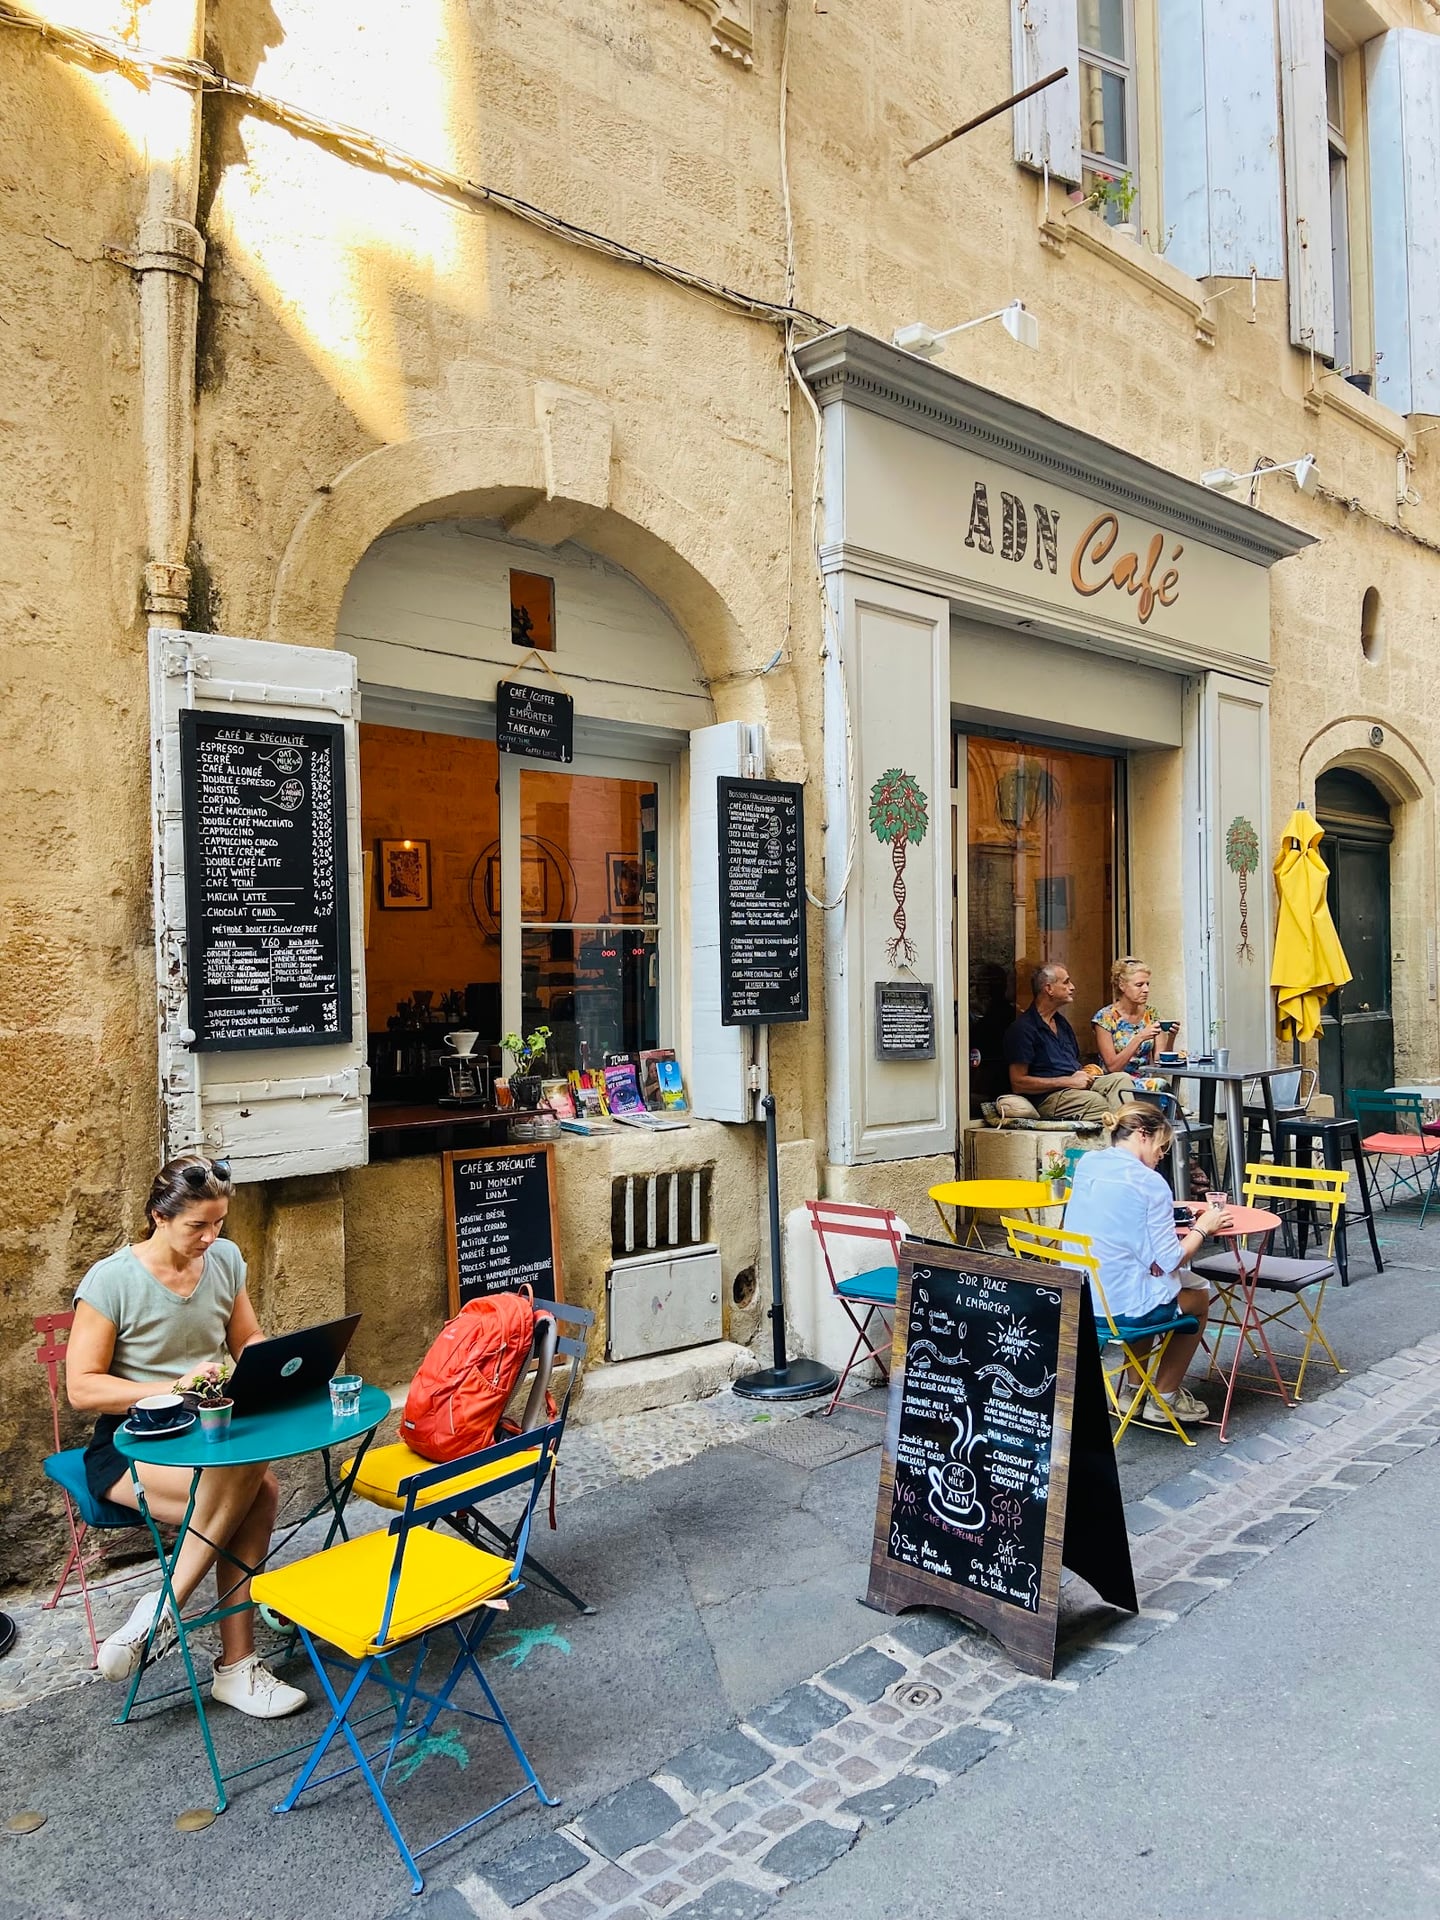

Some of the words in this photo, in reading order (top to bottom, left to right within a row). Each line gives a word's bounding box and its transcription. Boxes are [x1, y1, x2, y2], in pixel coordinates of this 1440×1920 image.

[964, 481, 1061, 575] ADN
[1070, 512, 1184, 624] Café
[510, 687, 527, 698] CAFÉ
[509, 707, 553, 723] EMPORTER
[218, 729, 240, 740] CAFÉ
[245, 731, 254, 740] DE
[507, 722, 550, 737] TAKEAWAY
[200, 742, 245, 755] ESPRESSO
[279, 750, 292, 758] OAT
[201, 753, 231, 764] SERRÉ
[202, 763, 223, 774] CAFÉ
[227, 765, 262, 777] ALLONGÉ
[201, 774, 234, 784] DOUBLE
[236, 777, 276, 787] ESPRESSO
[203, 784, 239, 795] NOISETTE
[203, 795, 240, 805] CORTADO
[203, 804, 224, 814] CAFÉ
[202, 816, 231, 825] DOUBLE
[233, 816, 250, 826] CAFÉ
[203, 827, 254, 836] CAPPUCCINO
[204, 837, 253, 846] CAPPUCCINO
[205, 857, 235, 866] DOUBLE
[237, 856, 256, 866] CAFÉ
[258, 858, 282, 867] LATTE
[206, 867, 227, 877] FLAT
[230, 867, 257, 877] WHITE
[206, 877, 229, 887] CAFÉ
[206, 892, 239, 901] MATCHA
[243, 892, 267, 901] LATTE
[206, 907, 248, 916] CHOCOLAT
[252, 907, 277, 916] CHAUD
[245, 925, 267, 933] DOUCE
[273, 925, 292, 933] SLOW
[293, 924, 318, 933] COFFEE
[211, 1028, 225, 1039] THÉ
[225, 1028, 246, 1038] VERT
[460, 1160, 483, 1175] CAFÉ
[496, 1155, 537, 1171] SPÉCIALITÉ
[470, 1181, 482, 1190] DU
[487, 1175, 524, 1188] MOMENT
[485, 1189, 508, 1199] LINDA
[485, 1209, 506, 1220] BRÉSIL
[490, 1244, 508, 1255] BLEND
[489, 1256, 511, 1268] NATURE
[984, 1276, 1008, 1293] PLACE
[956, 1294, 962, 1305] A
[966, 1297, 1010, 1316] EMPORTER
[1000, 1345, 1022, 1357] OATLY
[906, 1395, 931, 1408] BROWNIE
[905, 1406, 937, 1419] CHOCOLATS
[987, 1428, 1001, 1440] PAIN
[934, 1442, 940, 1450] 2
[992, 1450, 1034, 1469] CROISSANT
[991, 1463, 1029, 1482] CROISSANT
[948, 1475, 965, 1488] MILK
[990, 1473, 1024, 1491] CHOCOLAT
[895, 1479, 916, 1504] V60
[946, 1491, 969, 1508] ADN
[990, 1493, 1021, 1516] COLD
[990, 1510, 1023, 1531] DRIP
[921, 1540, 938, 1558] place
[998, 1543, 1017, 1557] OAT
[1000, 1554, 1018, 1567] MILK
[981, 1574, 990, 1588] to
[991, 1577, 1008, 1594] take
[1009, 1588, 1031, 1608] away
